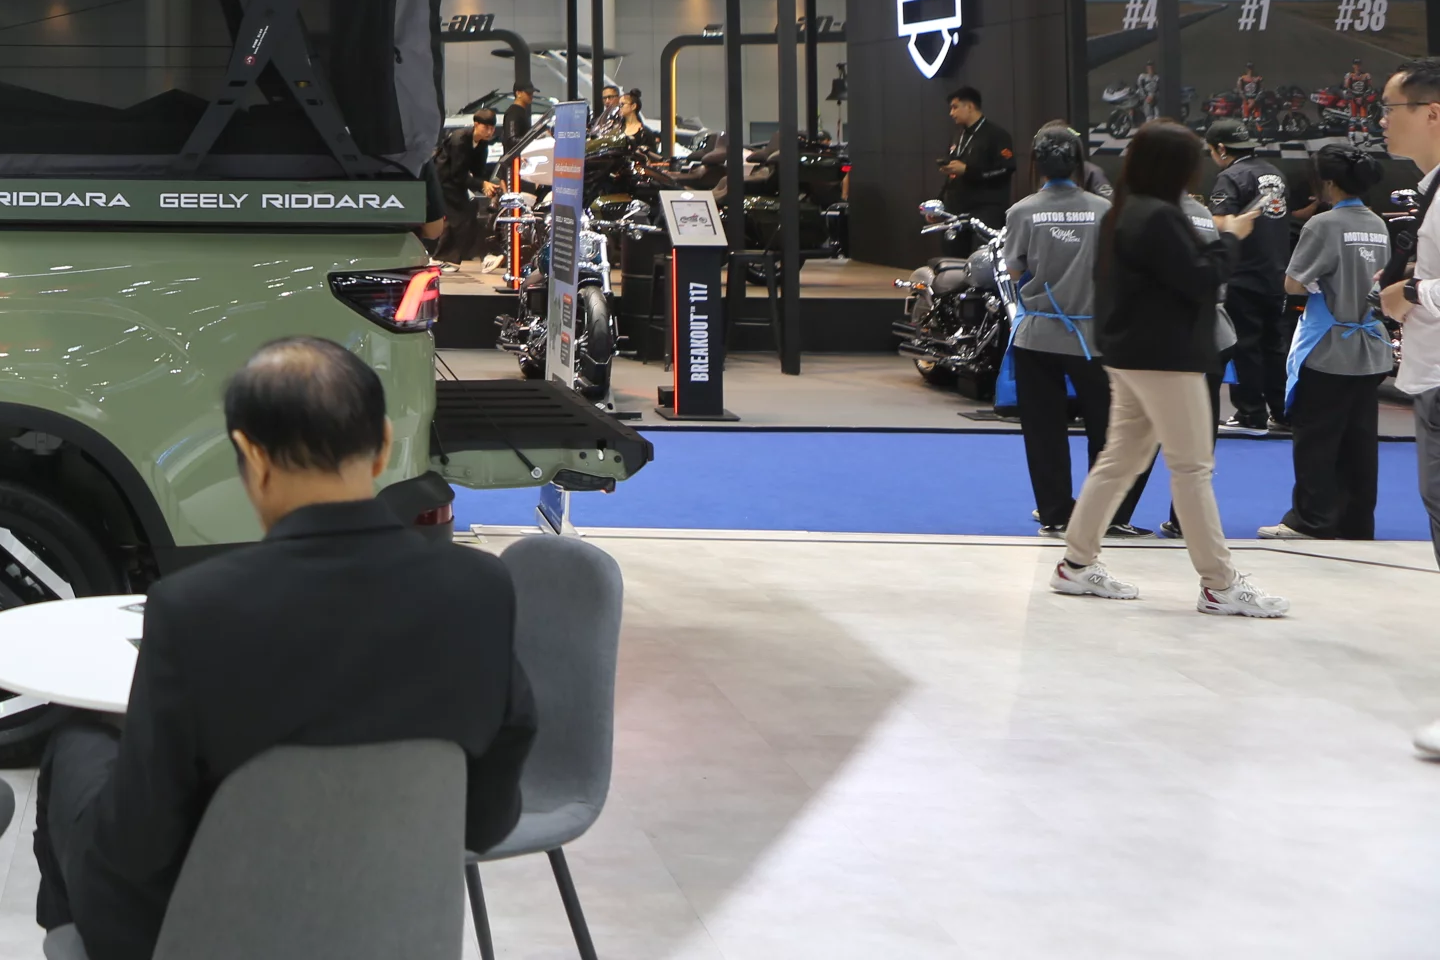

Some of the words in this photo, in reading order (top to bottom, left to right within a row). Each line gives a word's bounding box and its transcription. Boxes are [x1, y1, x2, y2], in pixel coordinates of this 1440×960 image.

[160, 193, 249, 208] GEELY
[262, 194, 405, 209] RIDDARA
[1032, 212, 1065, 224] MOTOR
[1065, 212, 1095, 222] SHOW
[1343, 232, 1369, 242] MOTOR
[689, 282, 708, 303] 117
